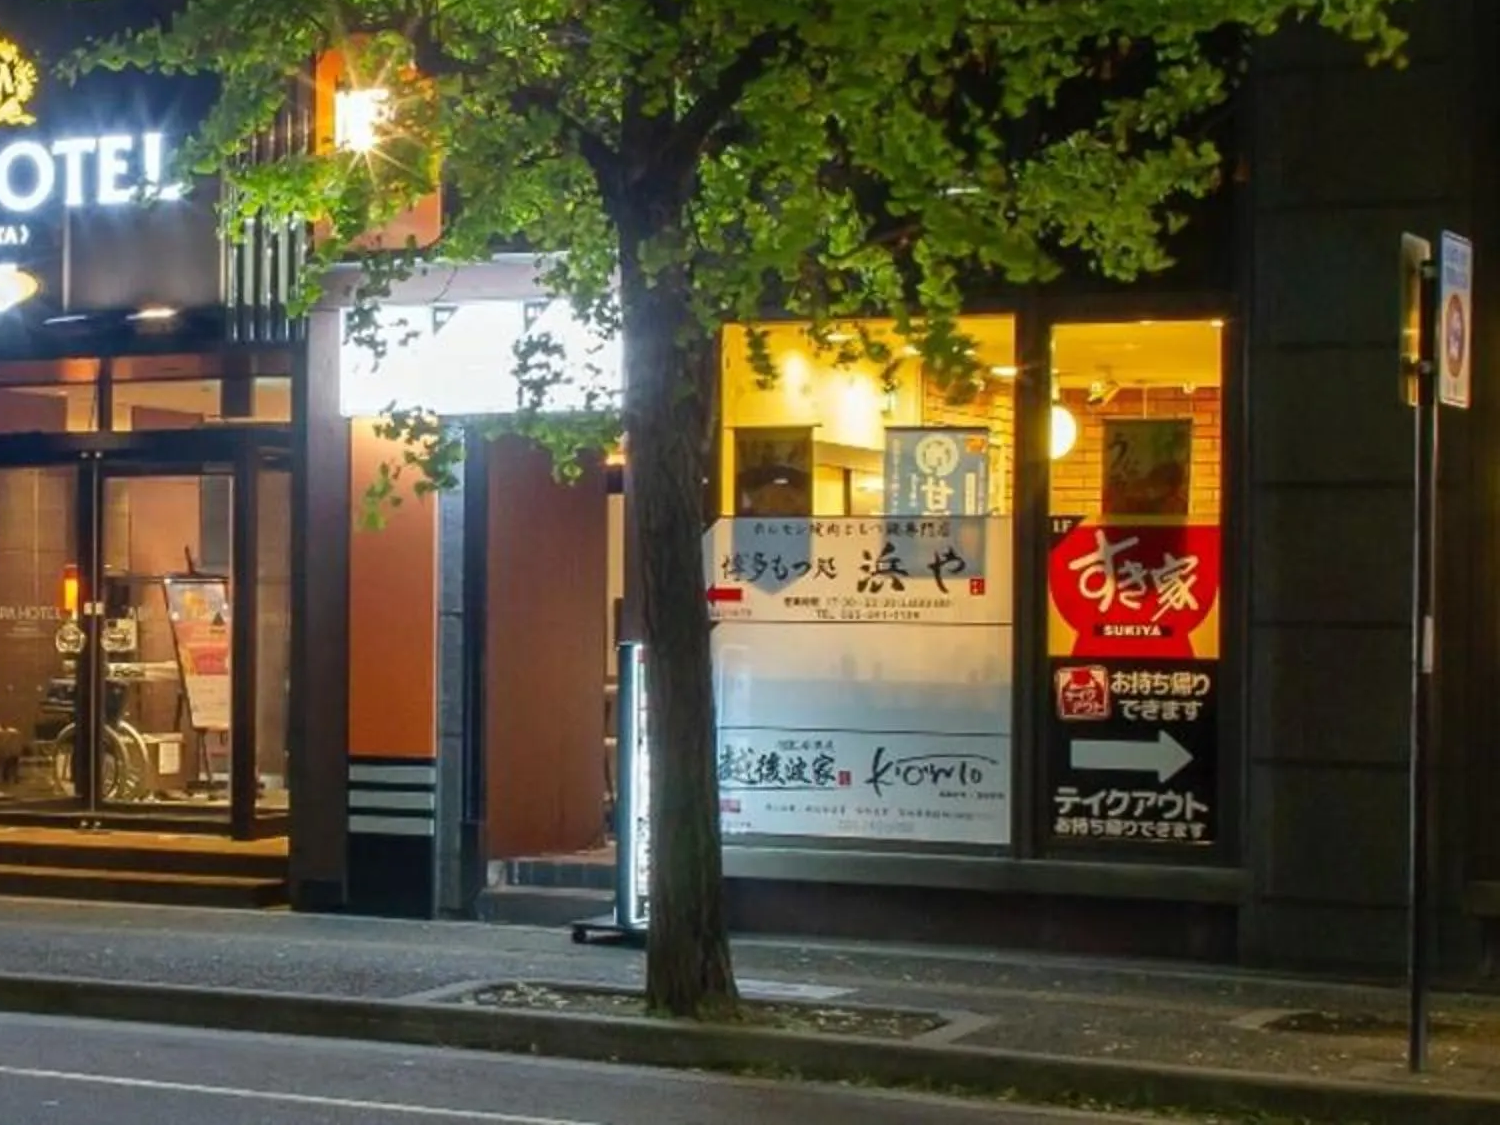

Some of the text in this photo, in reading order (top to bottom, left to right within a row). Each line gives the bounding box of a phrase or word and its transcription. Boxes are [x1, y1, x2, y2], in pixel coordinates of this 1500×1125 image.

[856, 541, 967, 595] 浜や
[1068, 528, 1199, 622] すき家
[1103, 624, 1163, 637] SUKIYA
[1110, 670, 1211, 696] お持ち帰り
[1118, 698, 1203, 721] できます
[1053, 786, 1209, 821] テイクアウト
[1054, 817, 1207, 838] お持ち帰りできます
